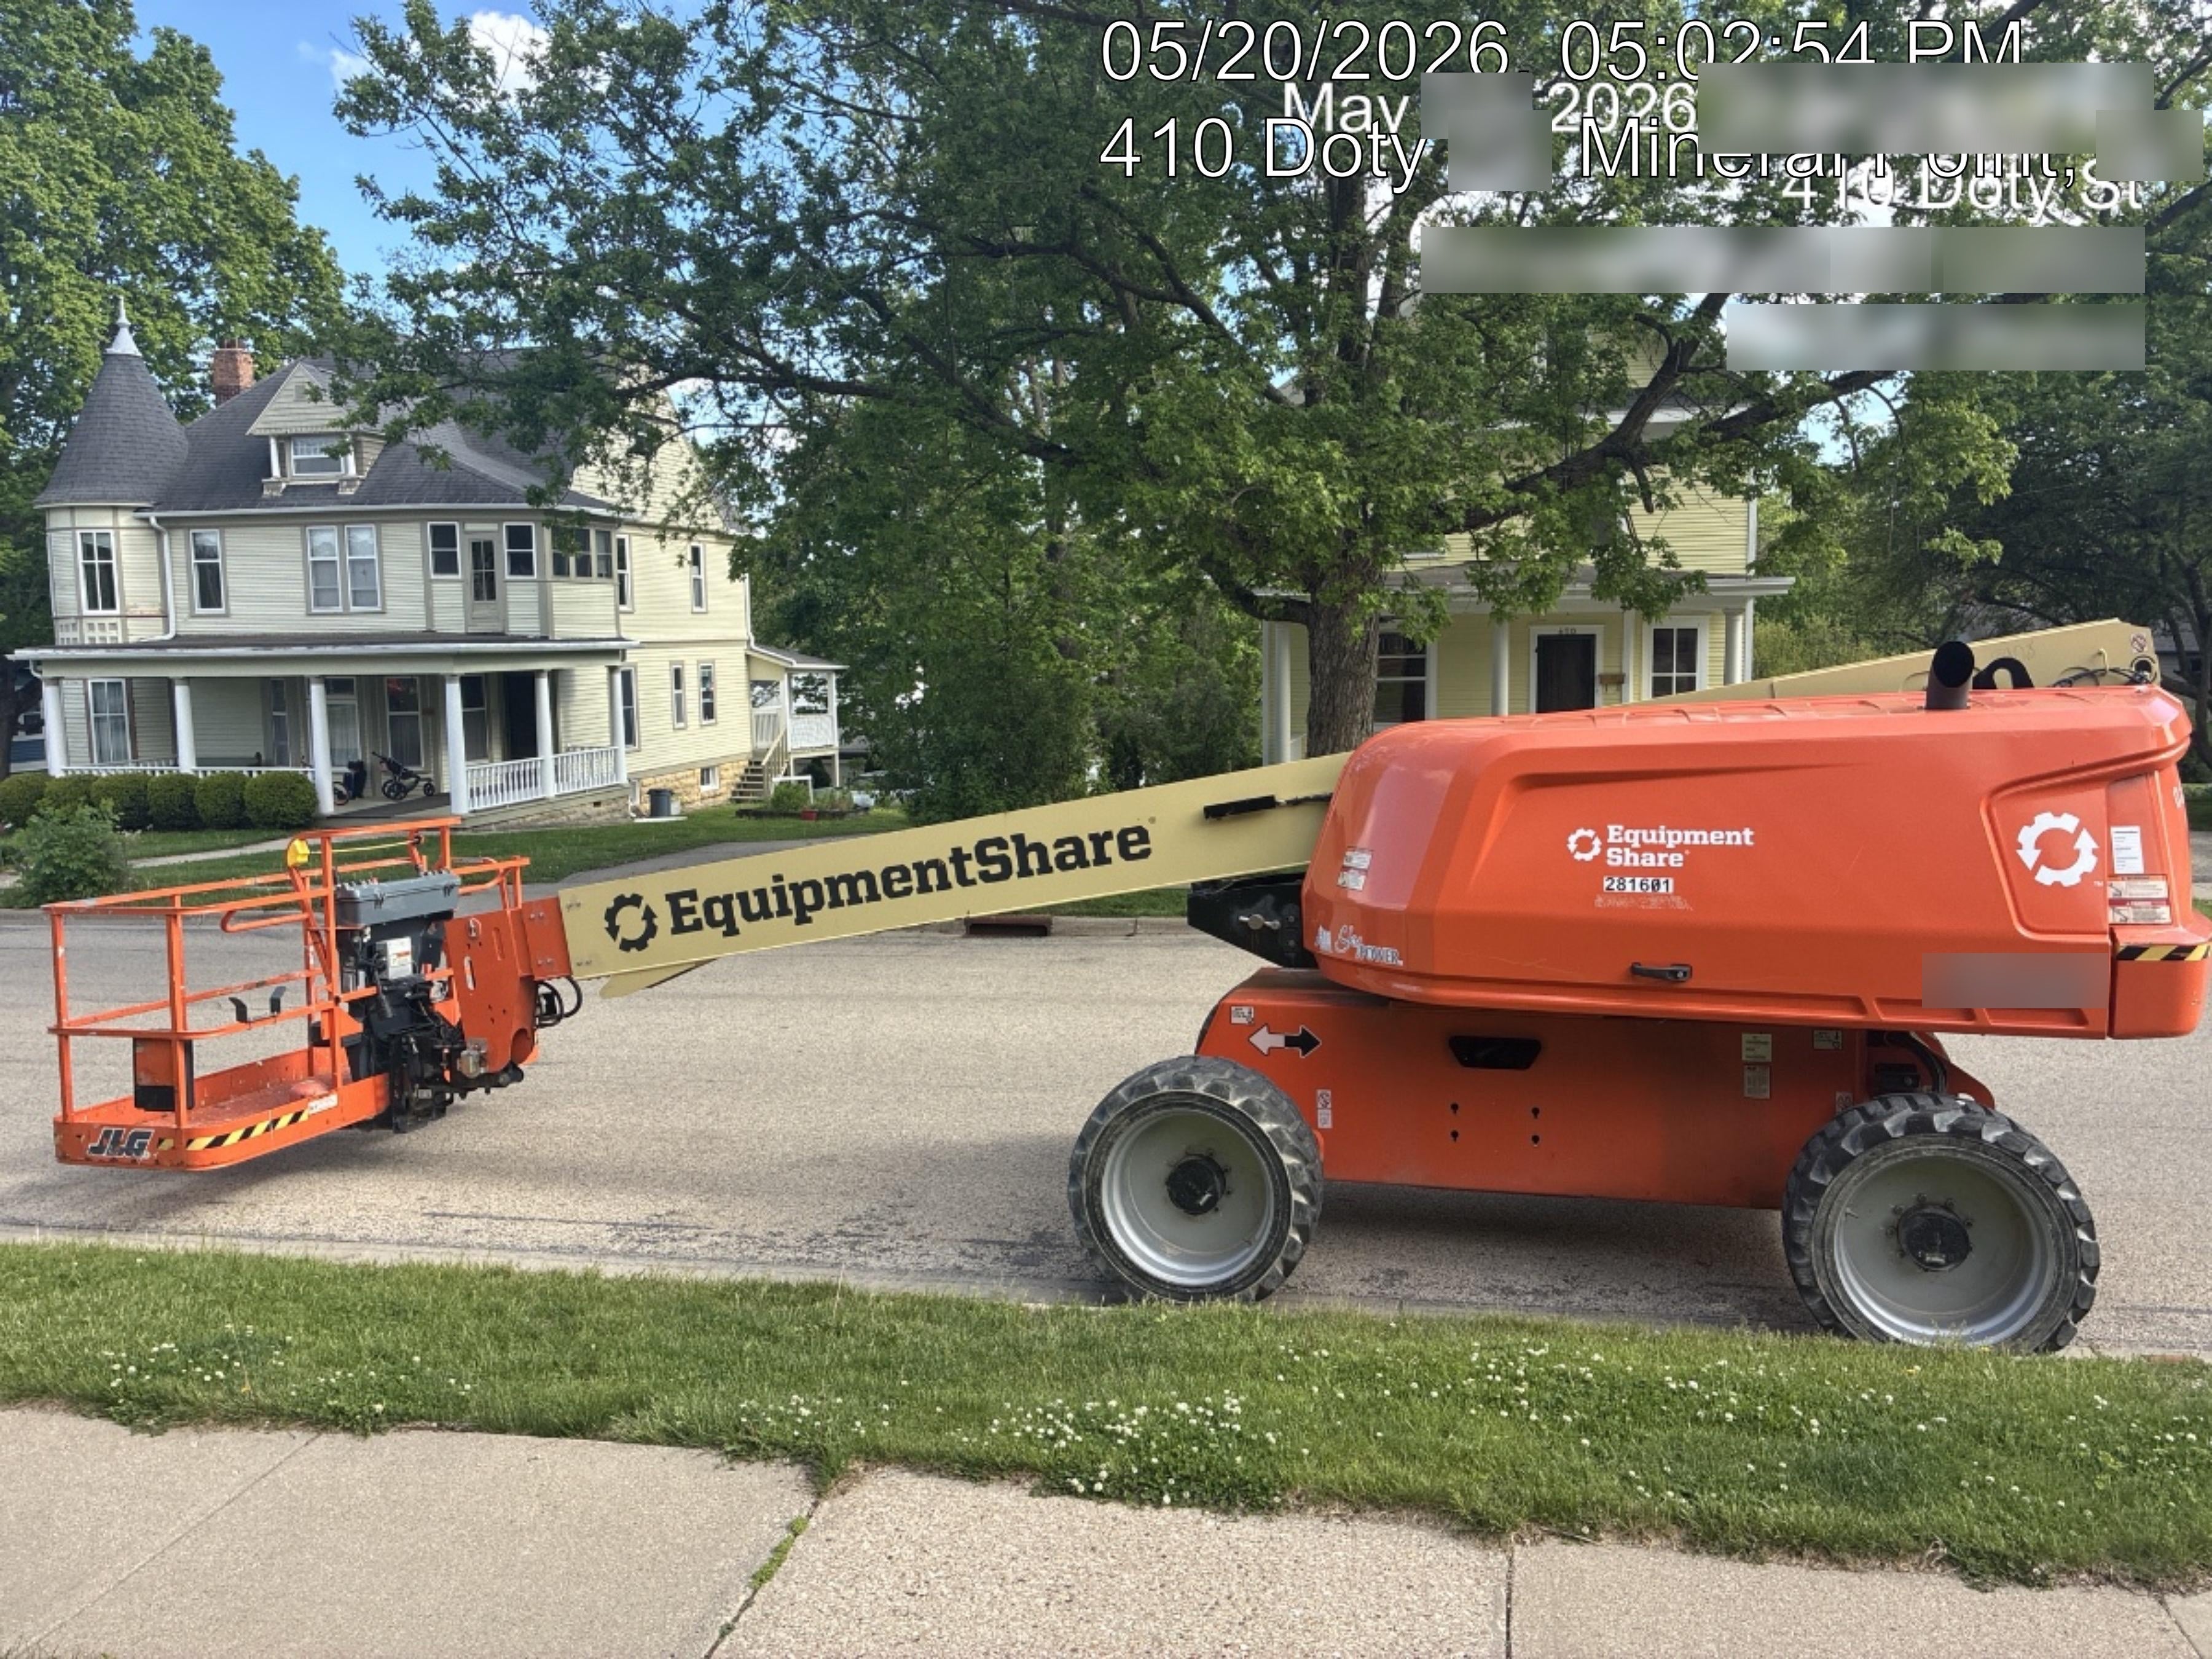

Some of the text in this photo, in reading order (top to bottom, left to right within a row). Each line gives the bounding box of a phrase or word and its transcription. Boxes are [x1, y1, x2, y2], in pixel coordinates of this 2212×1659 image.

[1607, 825, 1755, 849] Equipment
[1606, 847, 1684, 867] Share
[665, 825, 1152, 938] EquipmentShare
[1604, 876, 1671, 893] 281601
[86, 1126, 155, 1158] JLG
